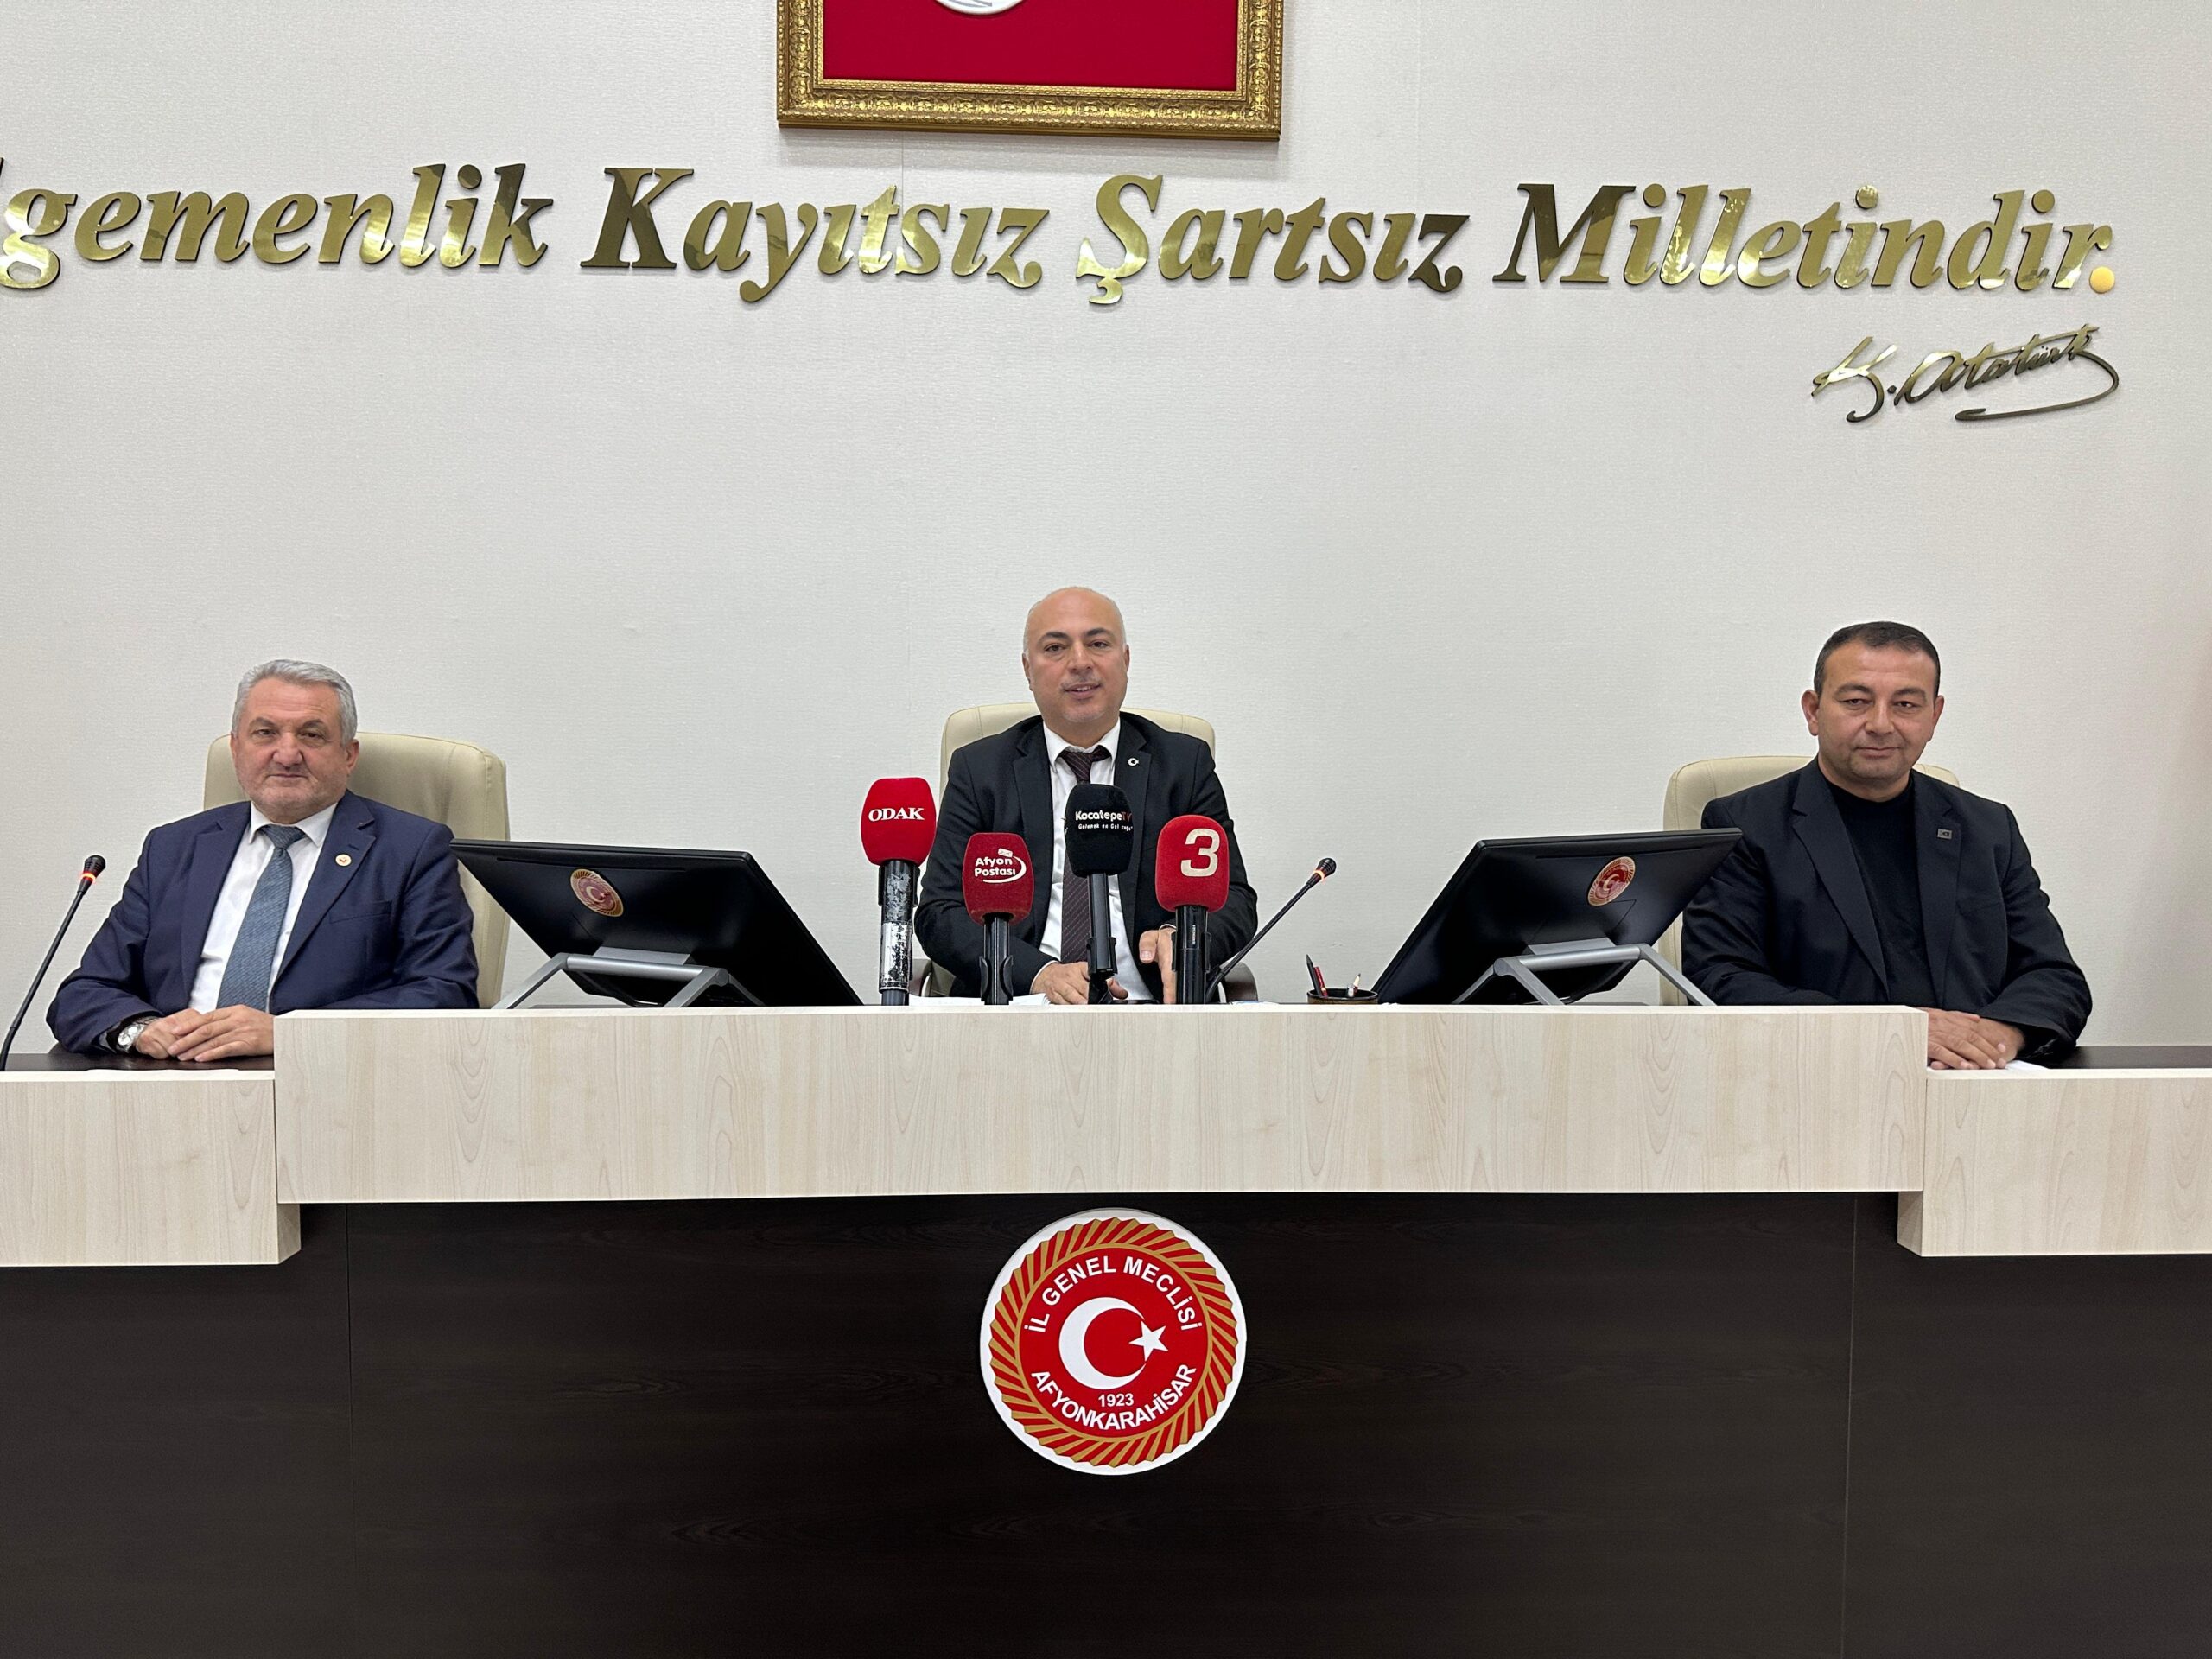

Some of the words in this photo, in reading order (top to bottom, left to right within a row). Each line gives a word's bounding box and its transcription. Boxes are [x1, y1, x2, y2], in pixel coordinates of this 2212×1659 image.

[0, 157, 554, 291] gemenlik
[580, 167, 1050, 304] Kayıtsız
[1075, 174, 1471, 305] Şartsız
[1491, 183, 2115, 295] Milletindir.
[868, 807, 925, 822] ODAK
[975, 856, 1013, 868] Afyon
[1180, 828, 1220, 877] 3
[974, 866, 1016, 877] Postası
[1024, 1313, 1051, 1333] İL
[1041, 1255, 1117, 1306] GENEL
[1123, 1255, 1203, 1332] MECLİSİ
[1030, 1363, 1198, 1431] AFYONKARAHİSAR
[1097, 1393, 1135, 1408] 1923
